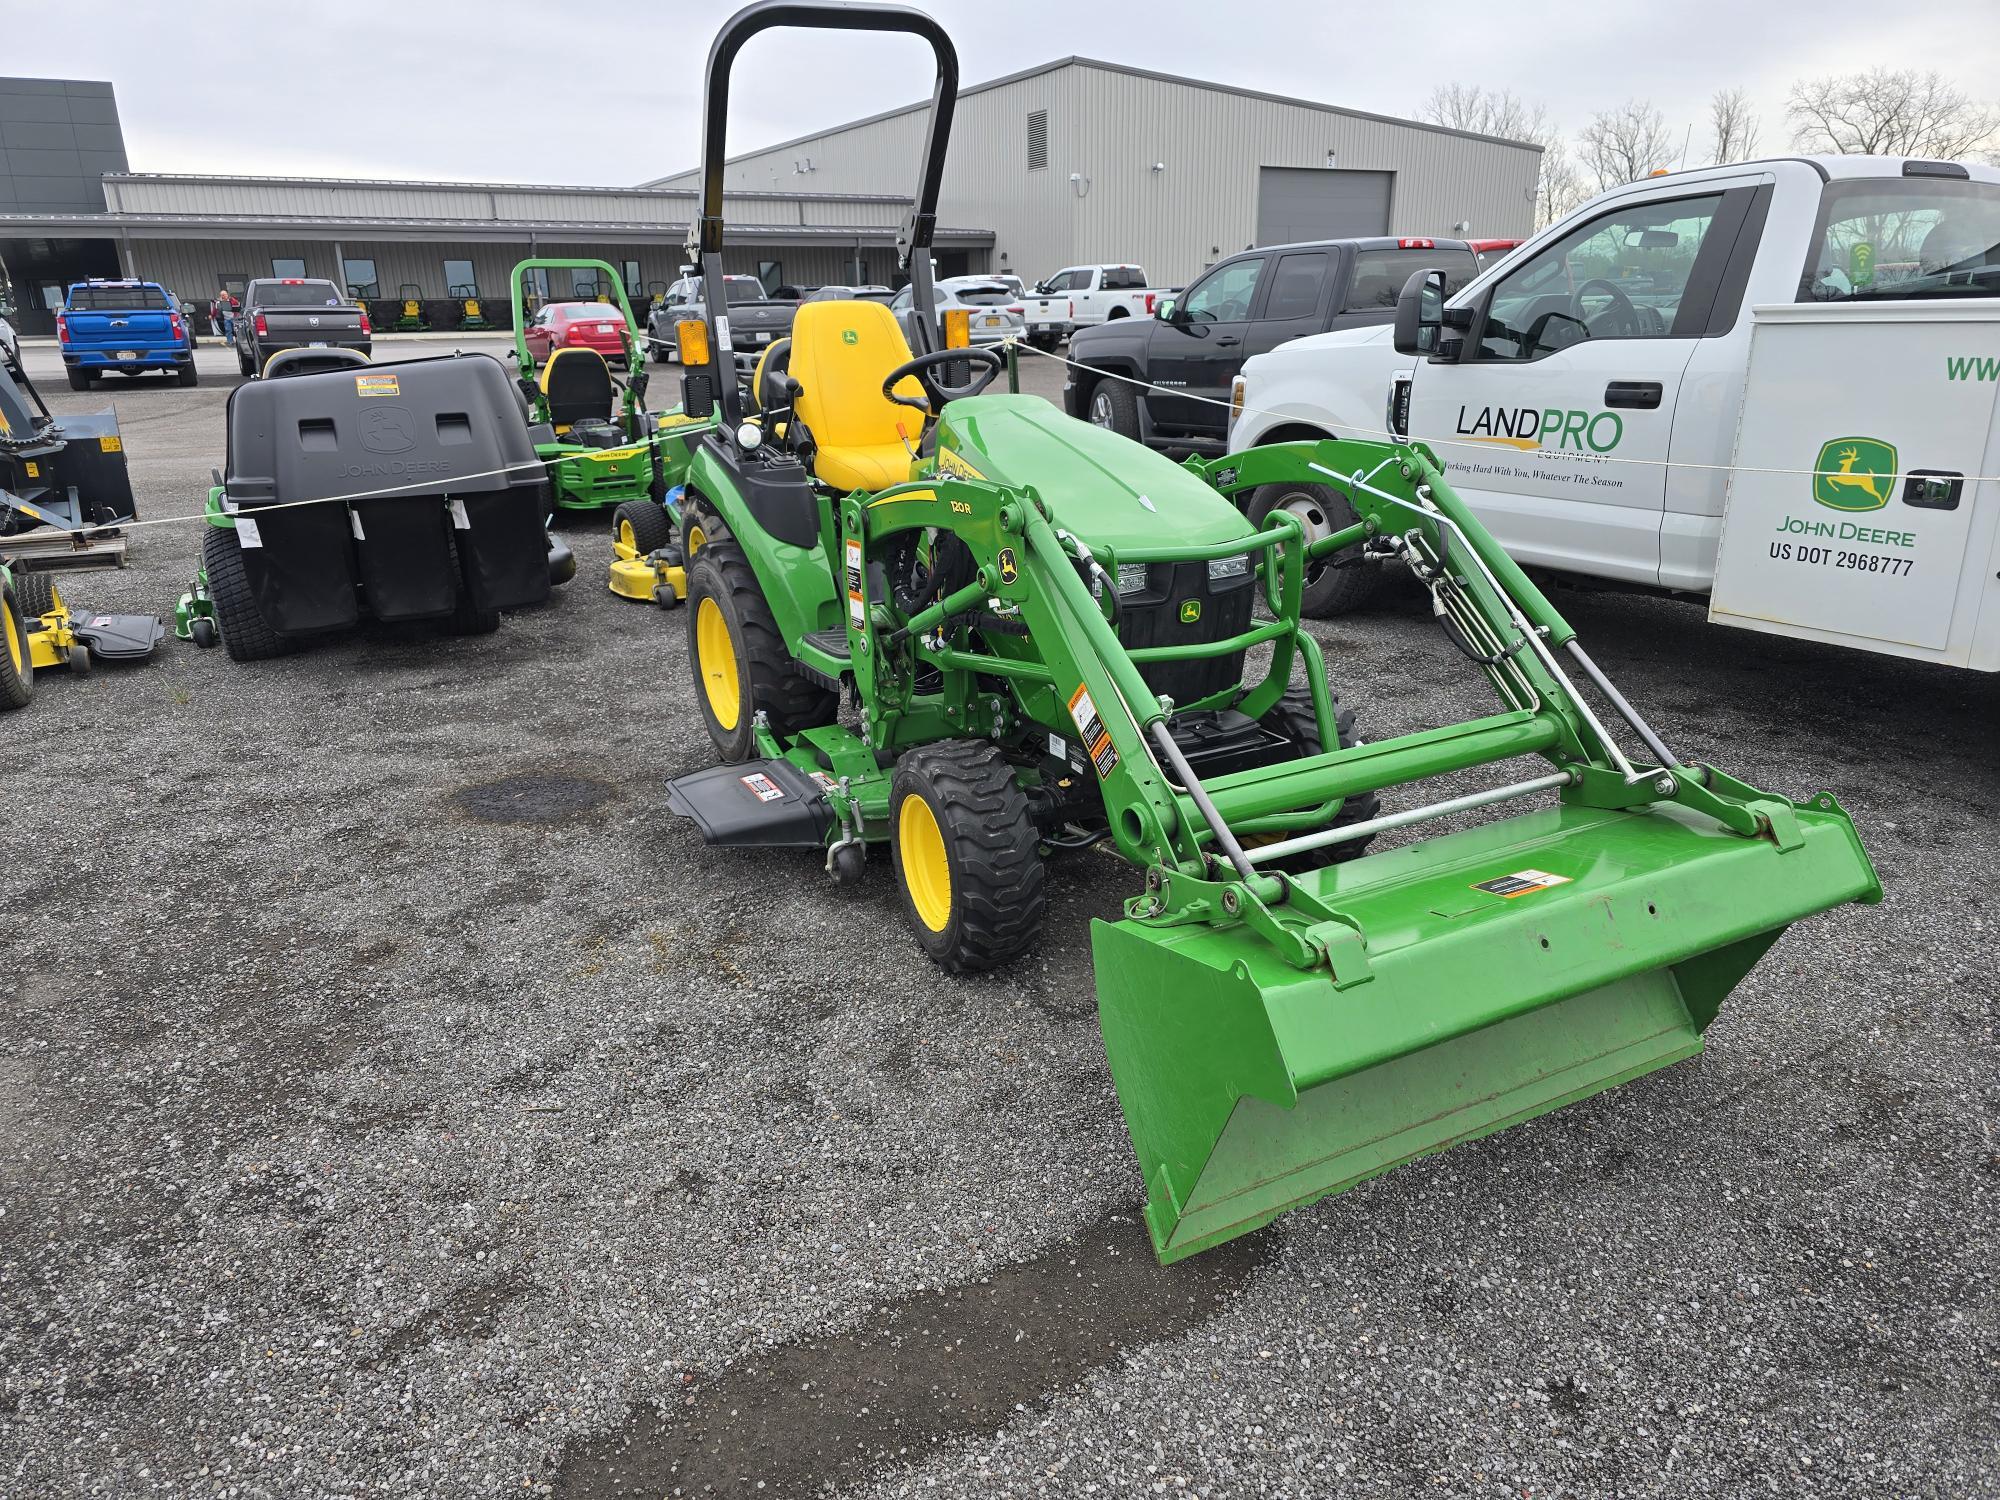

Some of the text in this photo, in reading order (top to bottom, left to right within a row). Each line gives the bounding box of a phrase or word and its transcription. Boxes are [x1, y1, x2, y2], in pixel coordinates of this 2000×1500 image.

[1456, 405, 1623, 453] LANDPRO
[338, 460, 450, 479] JOHN DEERE
[1537, 449, 1611, 464] EQUIPMENT
[1444, 460, 1623, 488] orking Hard With You, Whatever The Season
[1776, 515, 1916, 548] JOHN DEERE
[1769, 542, 1914, 577] US DOT 2968777
